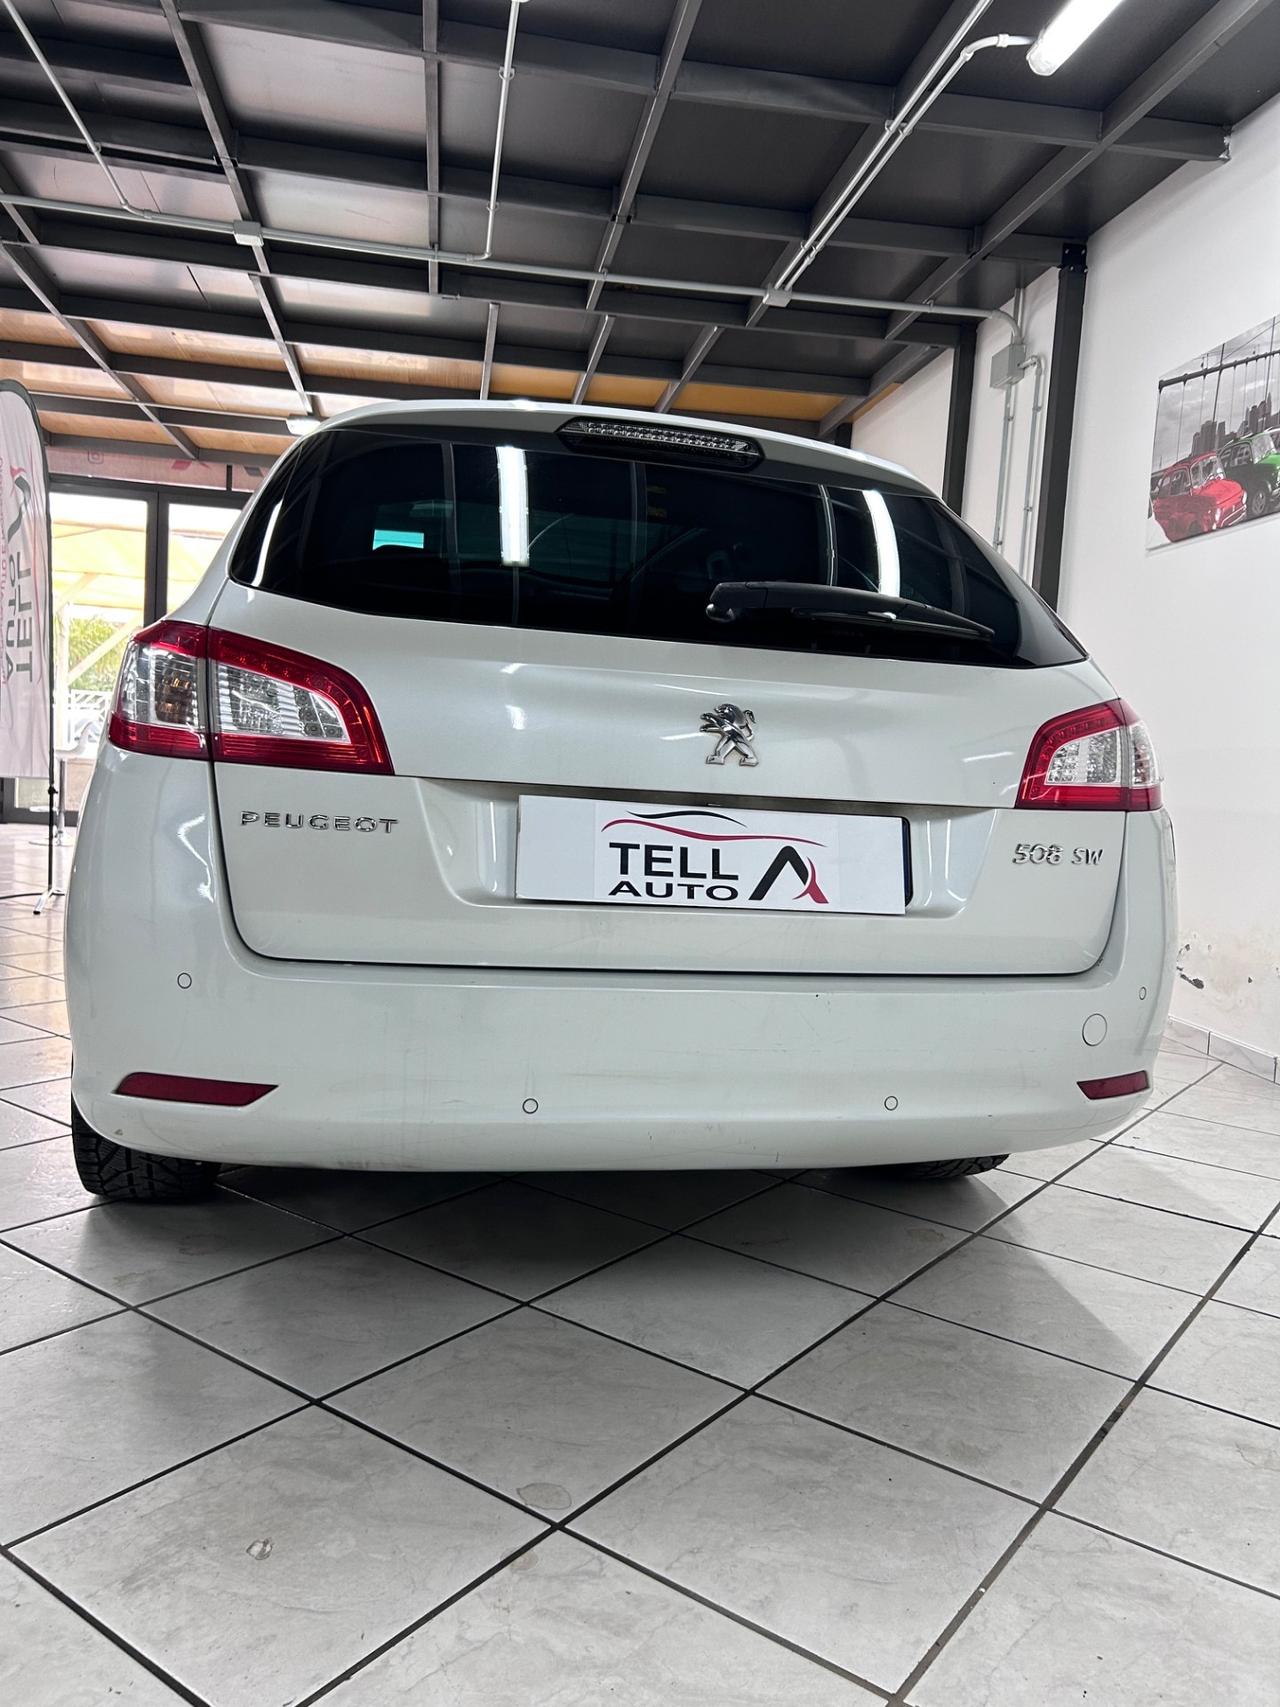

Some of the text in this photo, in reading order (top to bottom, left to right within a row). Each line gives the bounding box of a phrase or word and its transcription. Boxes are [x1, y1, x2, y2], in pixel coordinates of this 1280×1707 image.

[240, 810, 399, 833] PEUGEOT
[609, 842, 739, 881] TELL
[1012, 843, 1104, 866] 508 SW
[608, 880, 739, 901] AUTO
